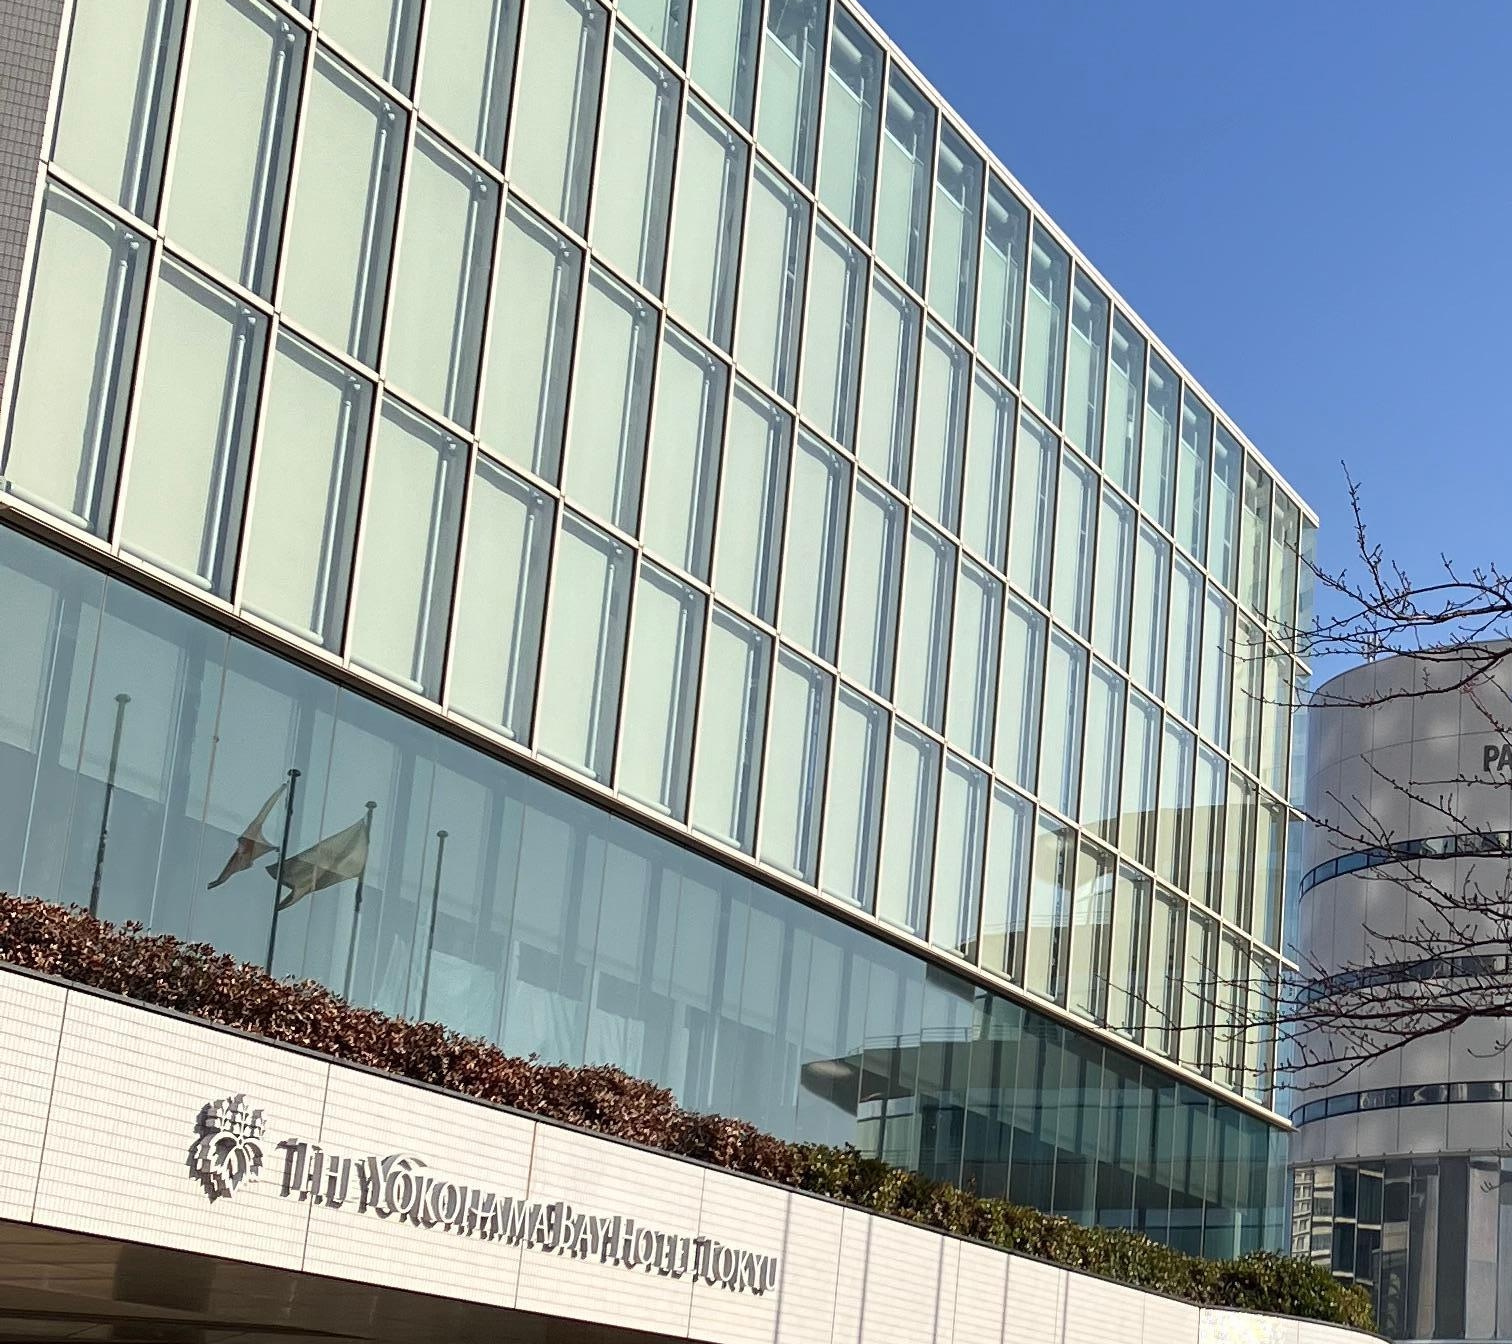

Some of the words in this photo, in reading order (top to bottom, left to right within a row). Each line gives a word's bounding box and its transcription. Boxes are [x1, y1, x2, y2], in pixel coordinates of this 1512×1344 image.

[358, 1152, 553, 1249] YOKOHAMA
[553, 1201, 613, 1259] BAY
[699, 1237, 780, 1295] TOKYU
